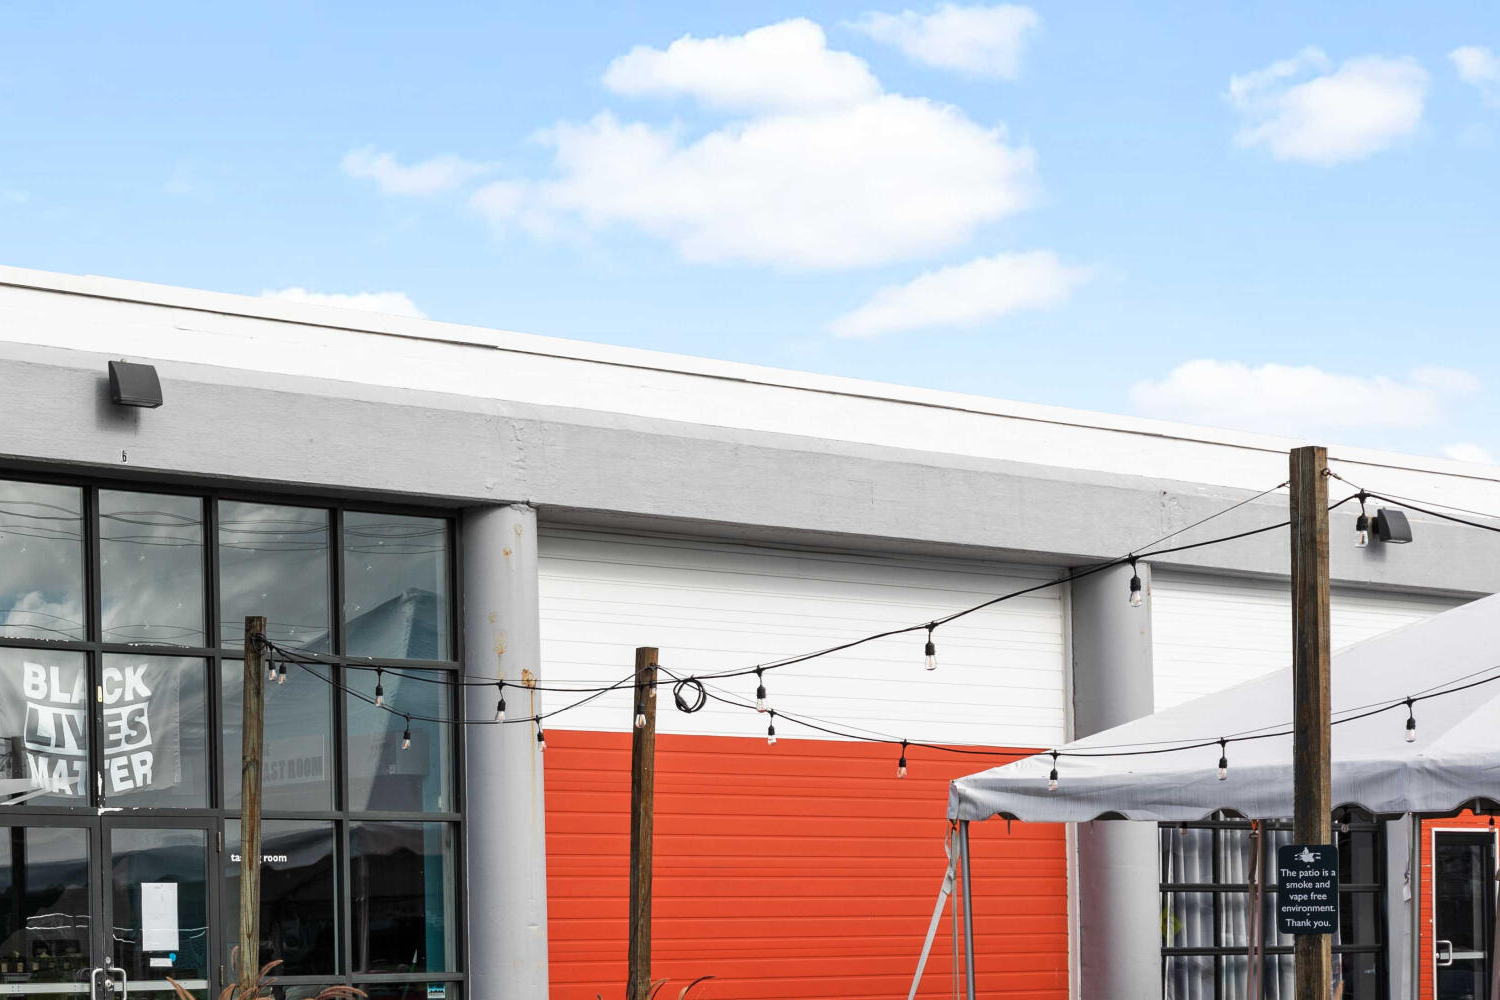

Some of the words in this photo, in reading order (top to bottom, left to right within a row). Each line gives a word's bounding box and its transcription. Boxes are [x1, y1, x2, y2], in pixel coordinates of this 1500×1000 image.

[26, 750, 154, 796] MATER
[263, 854, 288, 863] room
[1280, 868, 1297, 877] The
[1299, 868, 1320, 879] patio
[1322, 868, 1329, 877] is
[1286, 880, 1313, 889] smoke
[1315, 880, 1331, 889] and
[1289, 893, 1308, 902] vape
[1310, 891, 1327, 900] free
[1281, 904, 1336, 912] environment.
[1285, 918, 1312, 927] Thank
[1313, 921, 1331, 929] you.
